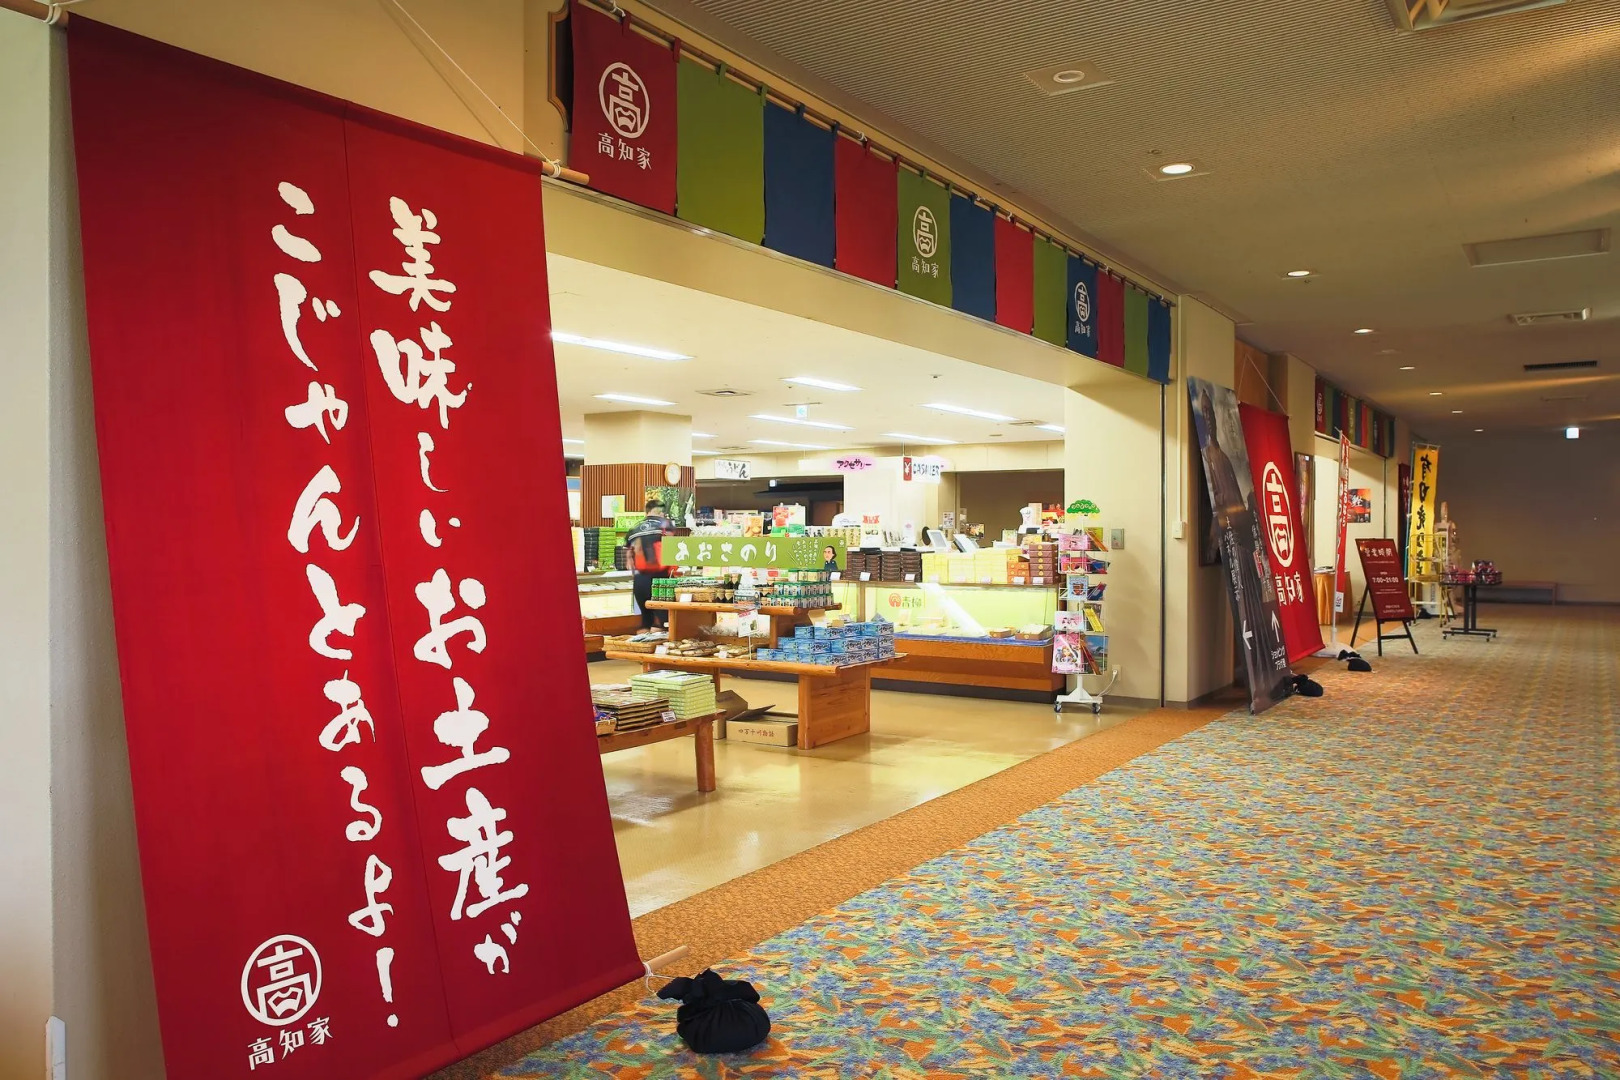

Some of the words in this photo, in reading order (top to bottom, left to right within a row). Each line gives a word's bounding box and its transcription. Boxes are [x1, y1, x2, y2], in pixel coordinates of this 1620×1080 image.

[598, 131, 652, 171] 高知家
[911, 255, 939, 279] 高知家
[675, 540, 777, 564] あおさのり
[369, 196, 529, 976] 美味しいお土産が
[1275, 571, 1304, 611] 高知家
[248, 1015, 333, 1071] 高知家
